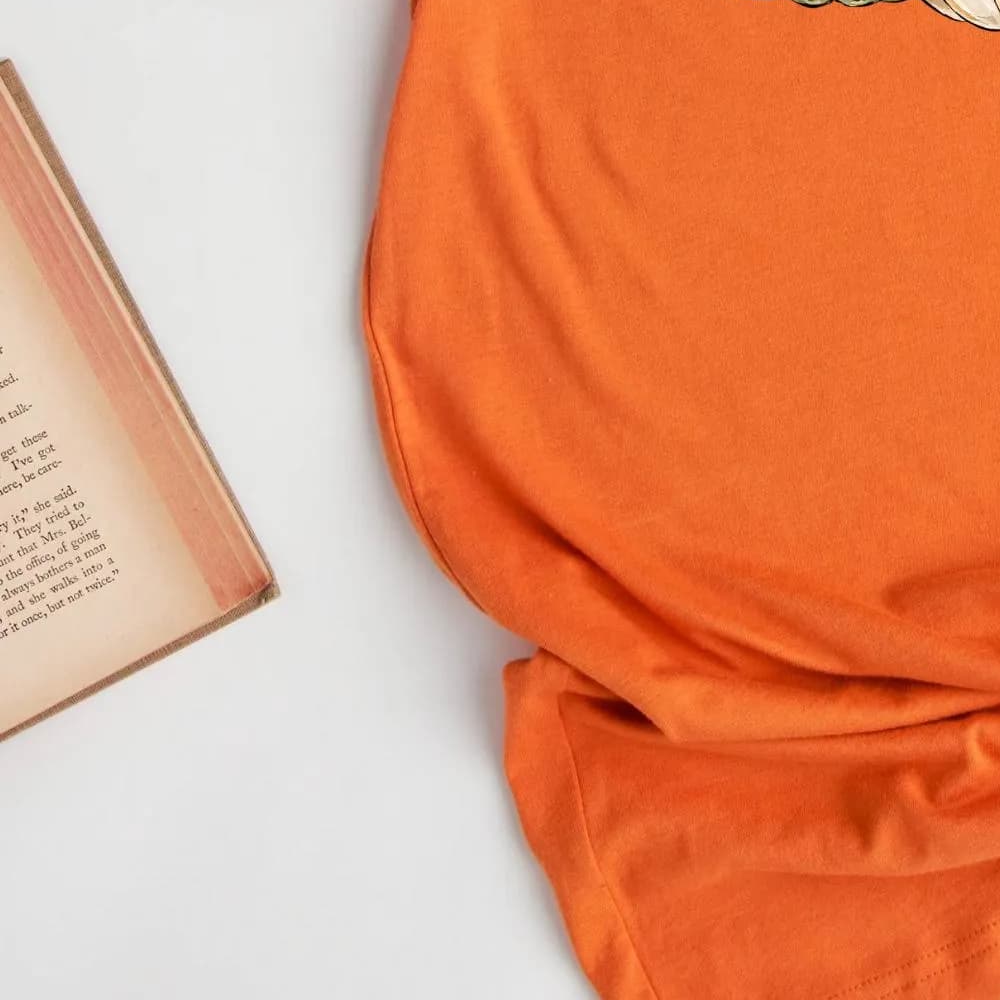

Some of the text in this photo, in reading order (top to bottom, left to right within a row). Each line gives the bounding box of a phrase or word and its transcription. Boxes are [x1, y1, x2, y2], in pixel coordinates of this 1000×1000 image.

[8, 403, 32, 419] talk-
[1, 446, 17, 462] get
[11, 444, 56, 471] I've got
[22, 473, 36, 483] be
[38, 460, 62, 476] care-
[33, 500, 51, 513] she
[54, 485, 77, 503] said.
[13, 501, 85, 539] They tried to
[17, 542, 38, 557] that
[40, 531, 67, 545] Mrs.
[68, 514, 92, 531] Bel-
[1, 580, 36, 601] always
[35, 560, 74, 583] bothers
[84, 543, 107, 559] man
[6, 568, 24, 581] the
[26, 554, 56, 571] office,
[57, 541, 68, 554] of
[71, 529, 101, 551] going
[5, 599, 25, 617] and
[29, 591, 47, 606] she
[50, 576, 80, 593] walks
[81, 563, 104, 577] into
[106, 557, 115, 565] a
[9, 622, 20, 633] it
[21, 611, 48, 627] once,
[46, 599, 66, 613] but
[67, 589, 84, 603] not
